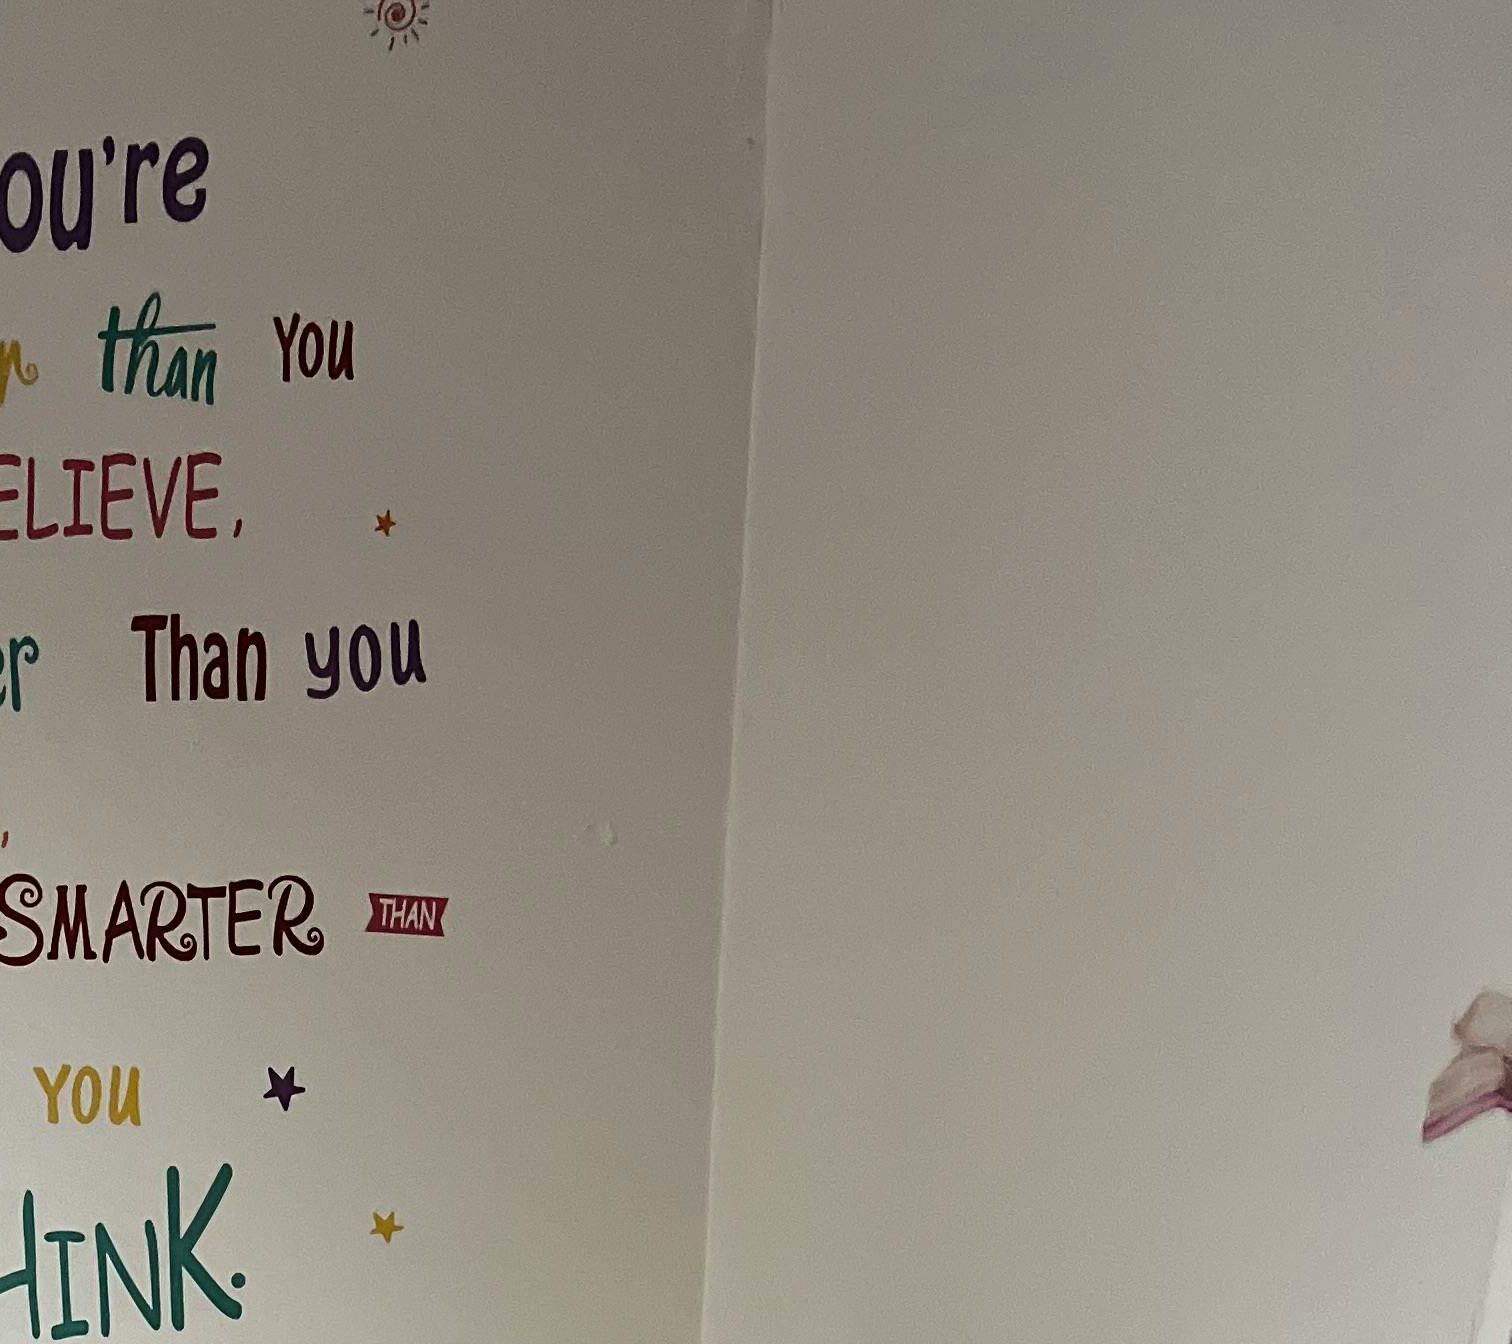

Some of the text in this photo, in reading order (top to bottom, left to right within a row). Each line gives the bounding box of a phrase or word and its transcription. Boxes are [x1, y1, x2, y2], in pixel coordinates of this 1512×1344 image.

[98, 292, 217, 405] than
[273, 313, 354, 382] You
[131, 614, 267, 702] Than
[305, 617, 426, 700] you
[379, 897, 437, 931] THAN
[33, 1063, 142, 1127] YOU
